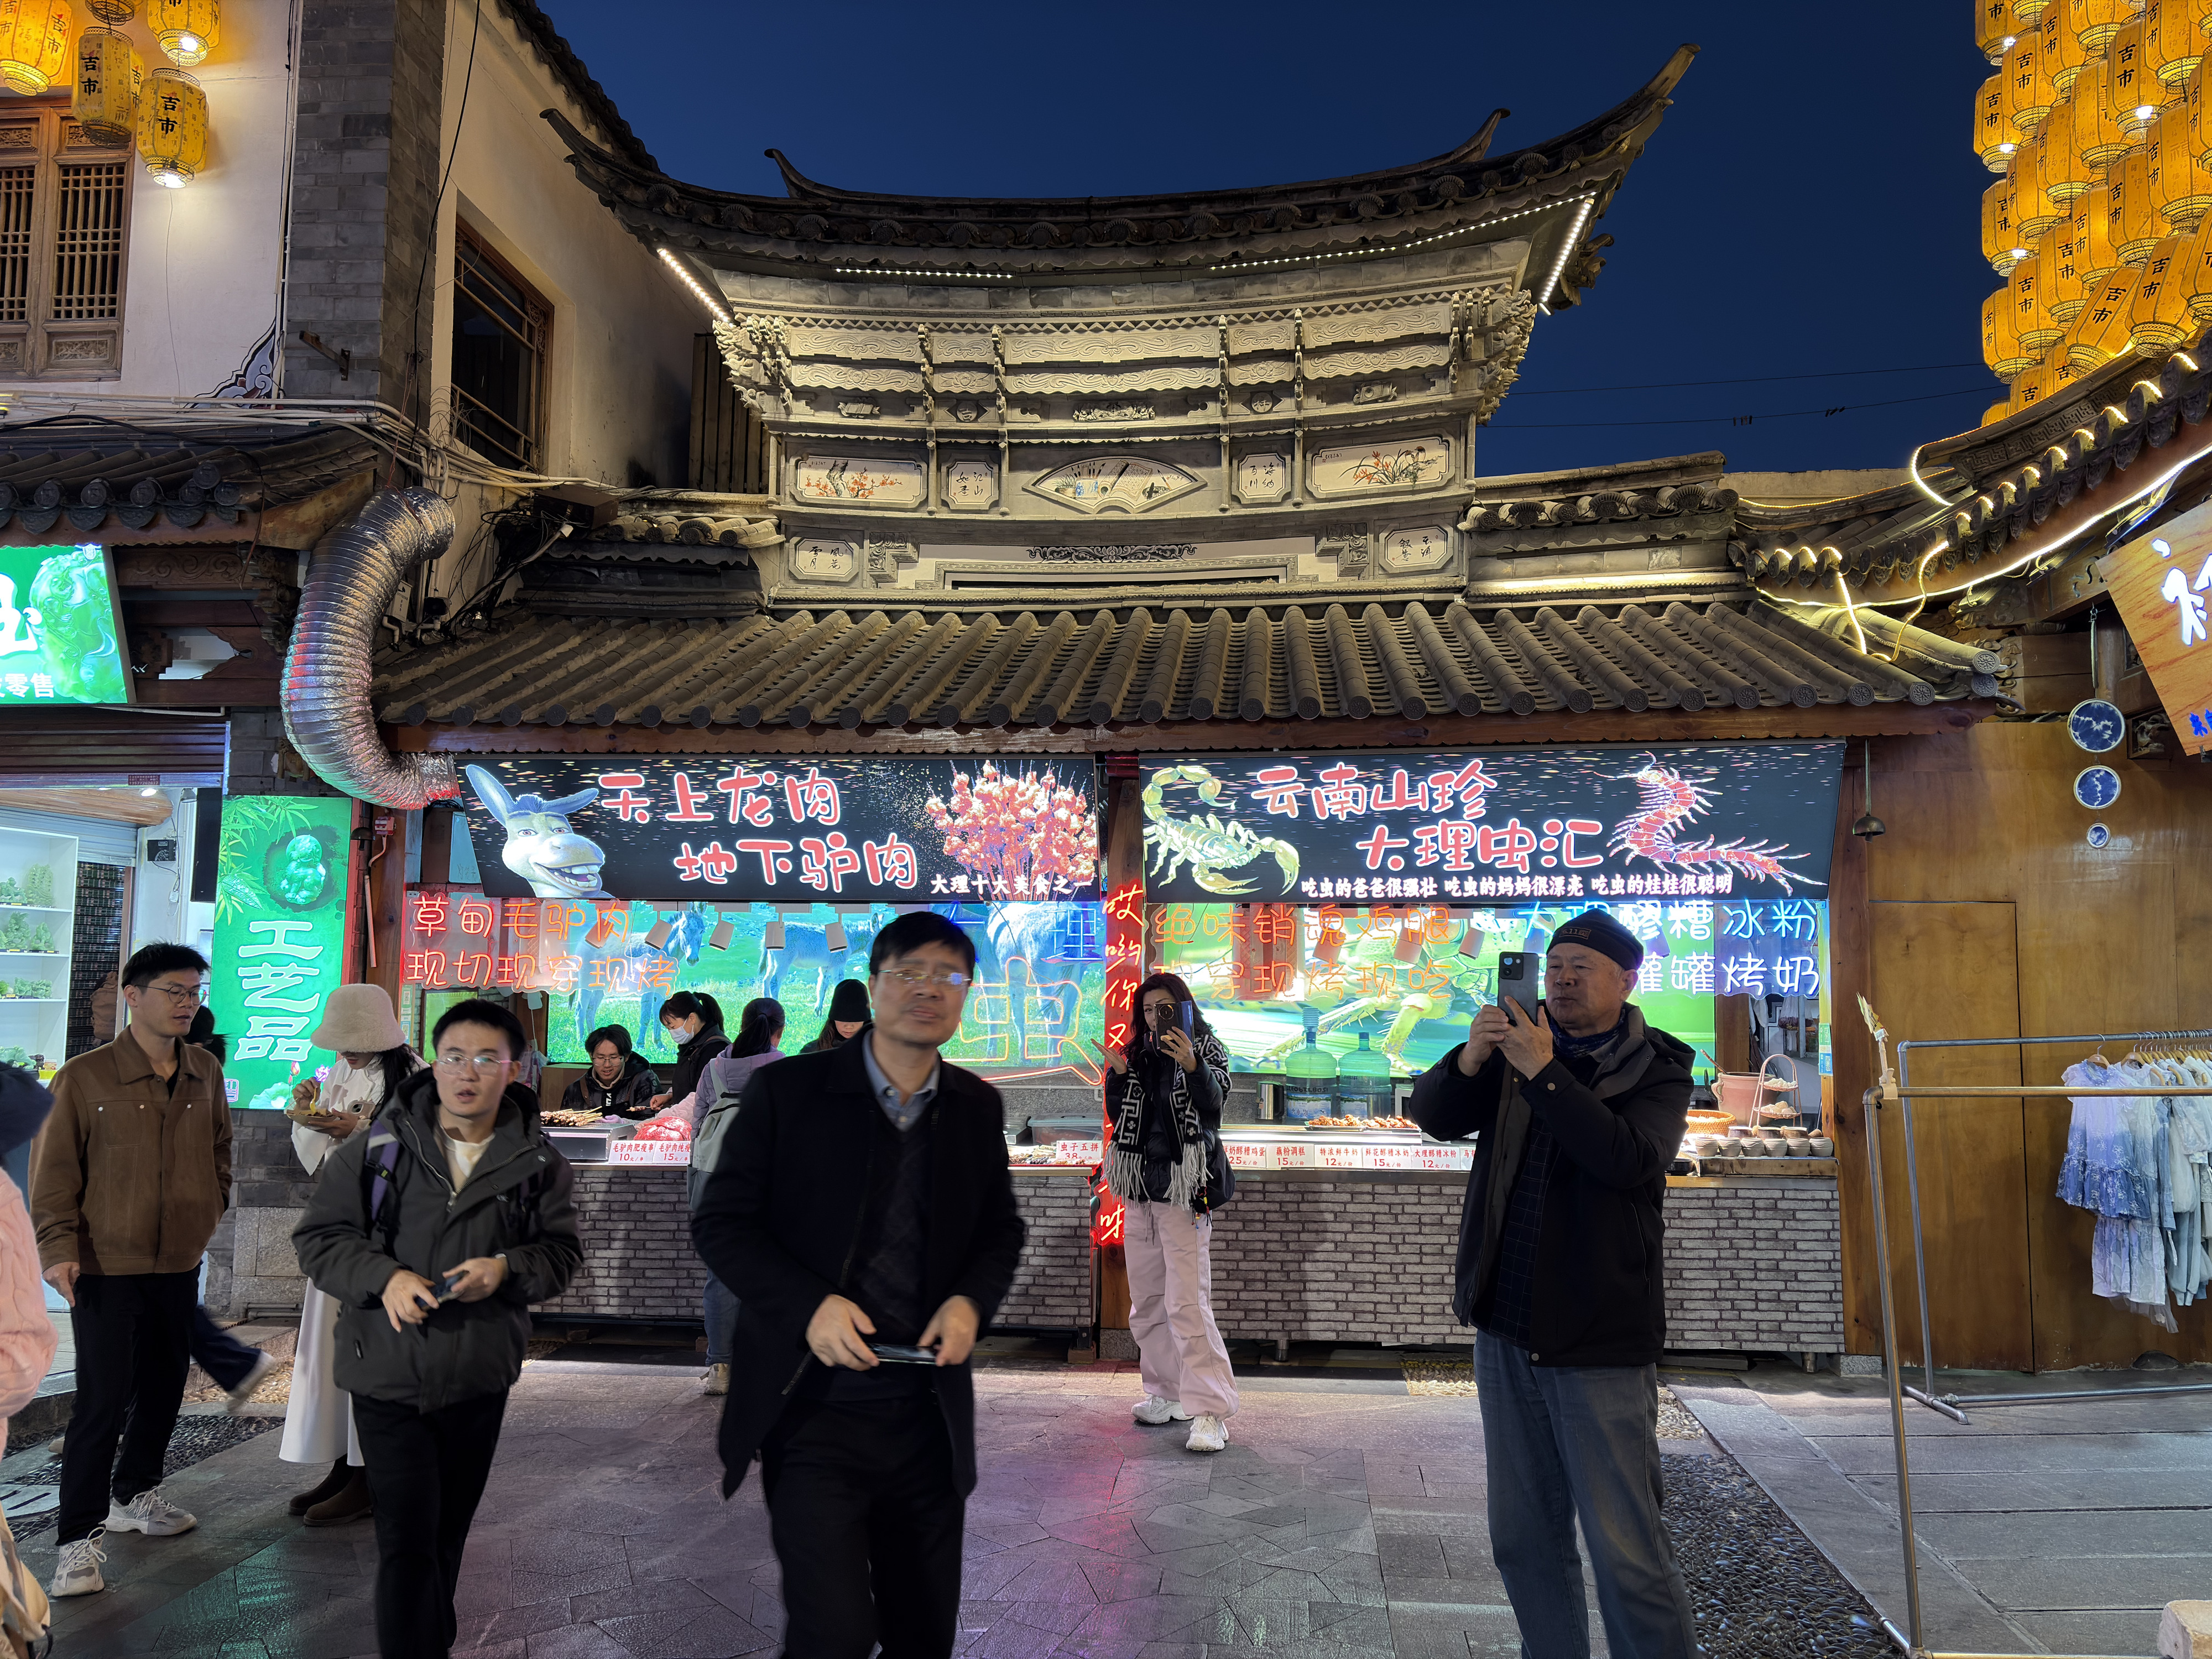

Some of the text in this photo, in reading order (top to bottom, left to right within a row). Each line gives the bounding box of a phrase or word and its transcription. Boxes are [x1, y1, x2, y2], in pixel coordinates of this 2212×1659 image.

[1988, 3, 2004, 19] 市
[2147, 2, 2159, 48] 吉市
[2044, 16, 2058, 55] 吉市
[81, 56, 100, 96] 吉市
[2016, 53, 2033, 90] 吉市
[2116, 44, 2136, 88] 吉市
[159, 95, 180, 134] 吉市
[1985, 92, 2001, 128] 吉市
[2149, 142, 2159, 187] 吉市
[2110, 182, 2123, 225] 吉市
[2075, 213, 2087, 254] 吉市
[2058, 243, 2074, 280] 吉市
[2143, 257, 2170, 300] 吉市
[2018, 276, 2034, 314] 吉市
[2092, 287, 2126, 324] 吉市
[1984, 311, 1993, 348] 吉市
[2022, 387, 2038, 403] 吉
[0, 672, 54, 698] 零售
[597, 765, 841, 827] 天上龙肉
[1251, 759, 1498, 822] 云南山珍
[673, 831, 917, 893] 地下驴肉
[1356, 818, 1603, 874] 大理虫汇
[930, 874, 1092, 894] 大理十大美食之一
[1301, 873, 1733, 899] 吃虫的爸爸很强壮 吃虫的妈妈很漂亮 吃虫的娃娃很聪明
[413, 895, 630, 943] 草甸毛驴肉
[1155, 904, 1450, 946] 绝味销魂鸡腿
[234, 920, 324, 1061] 工艺品
[407, 949, 676, 996] 现切现穿现烤
[613, 1143, 654, 1152] 毛驴肉肥瘦串
[1061, 1142, 1098, 1152] 虫子五拼
[1415, 1149, 1457, 1158] 大理醪糟冰粉
